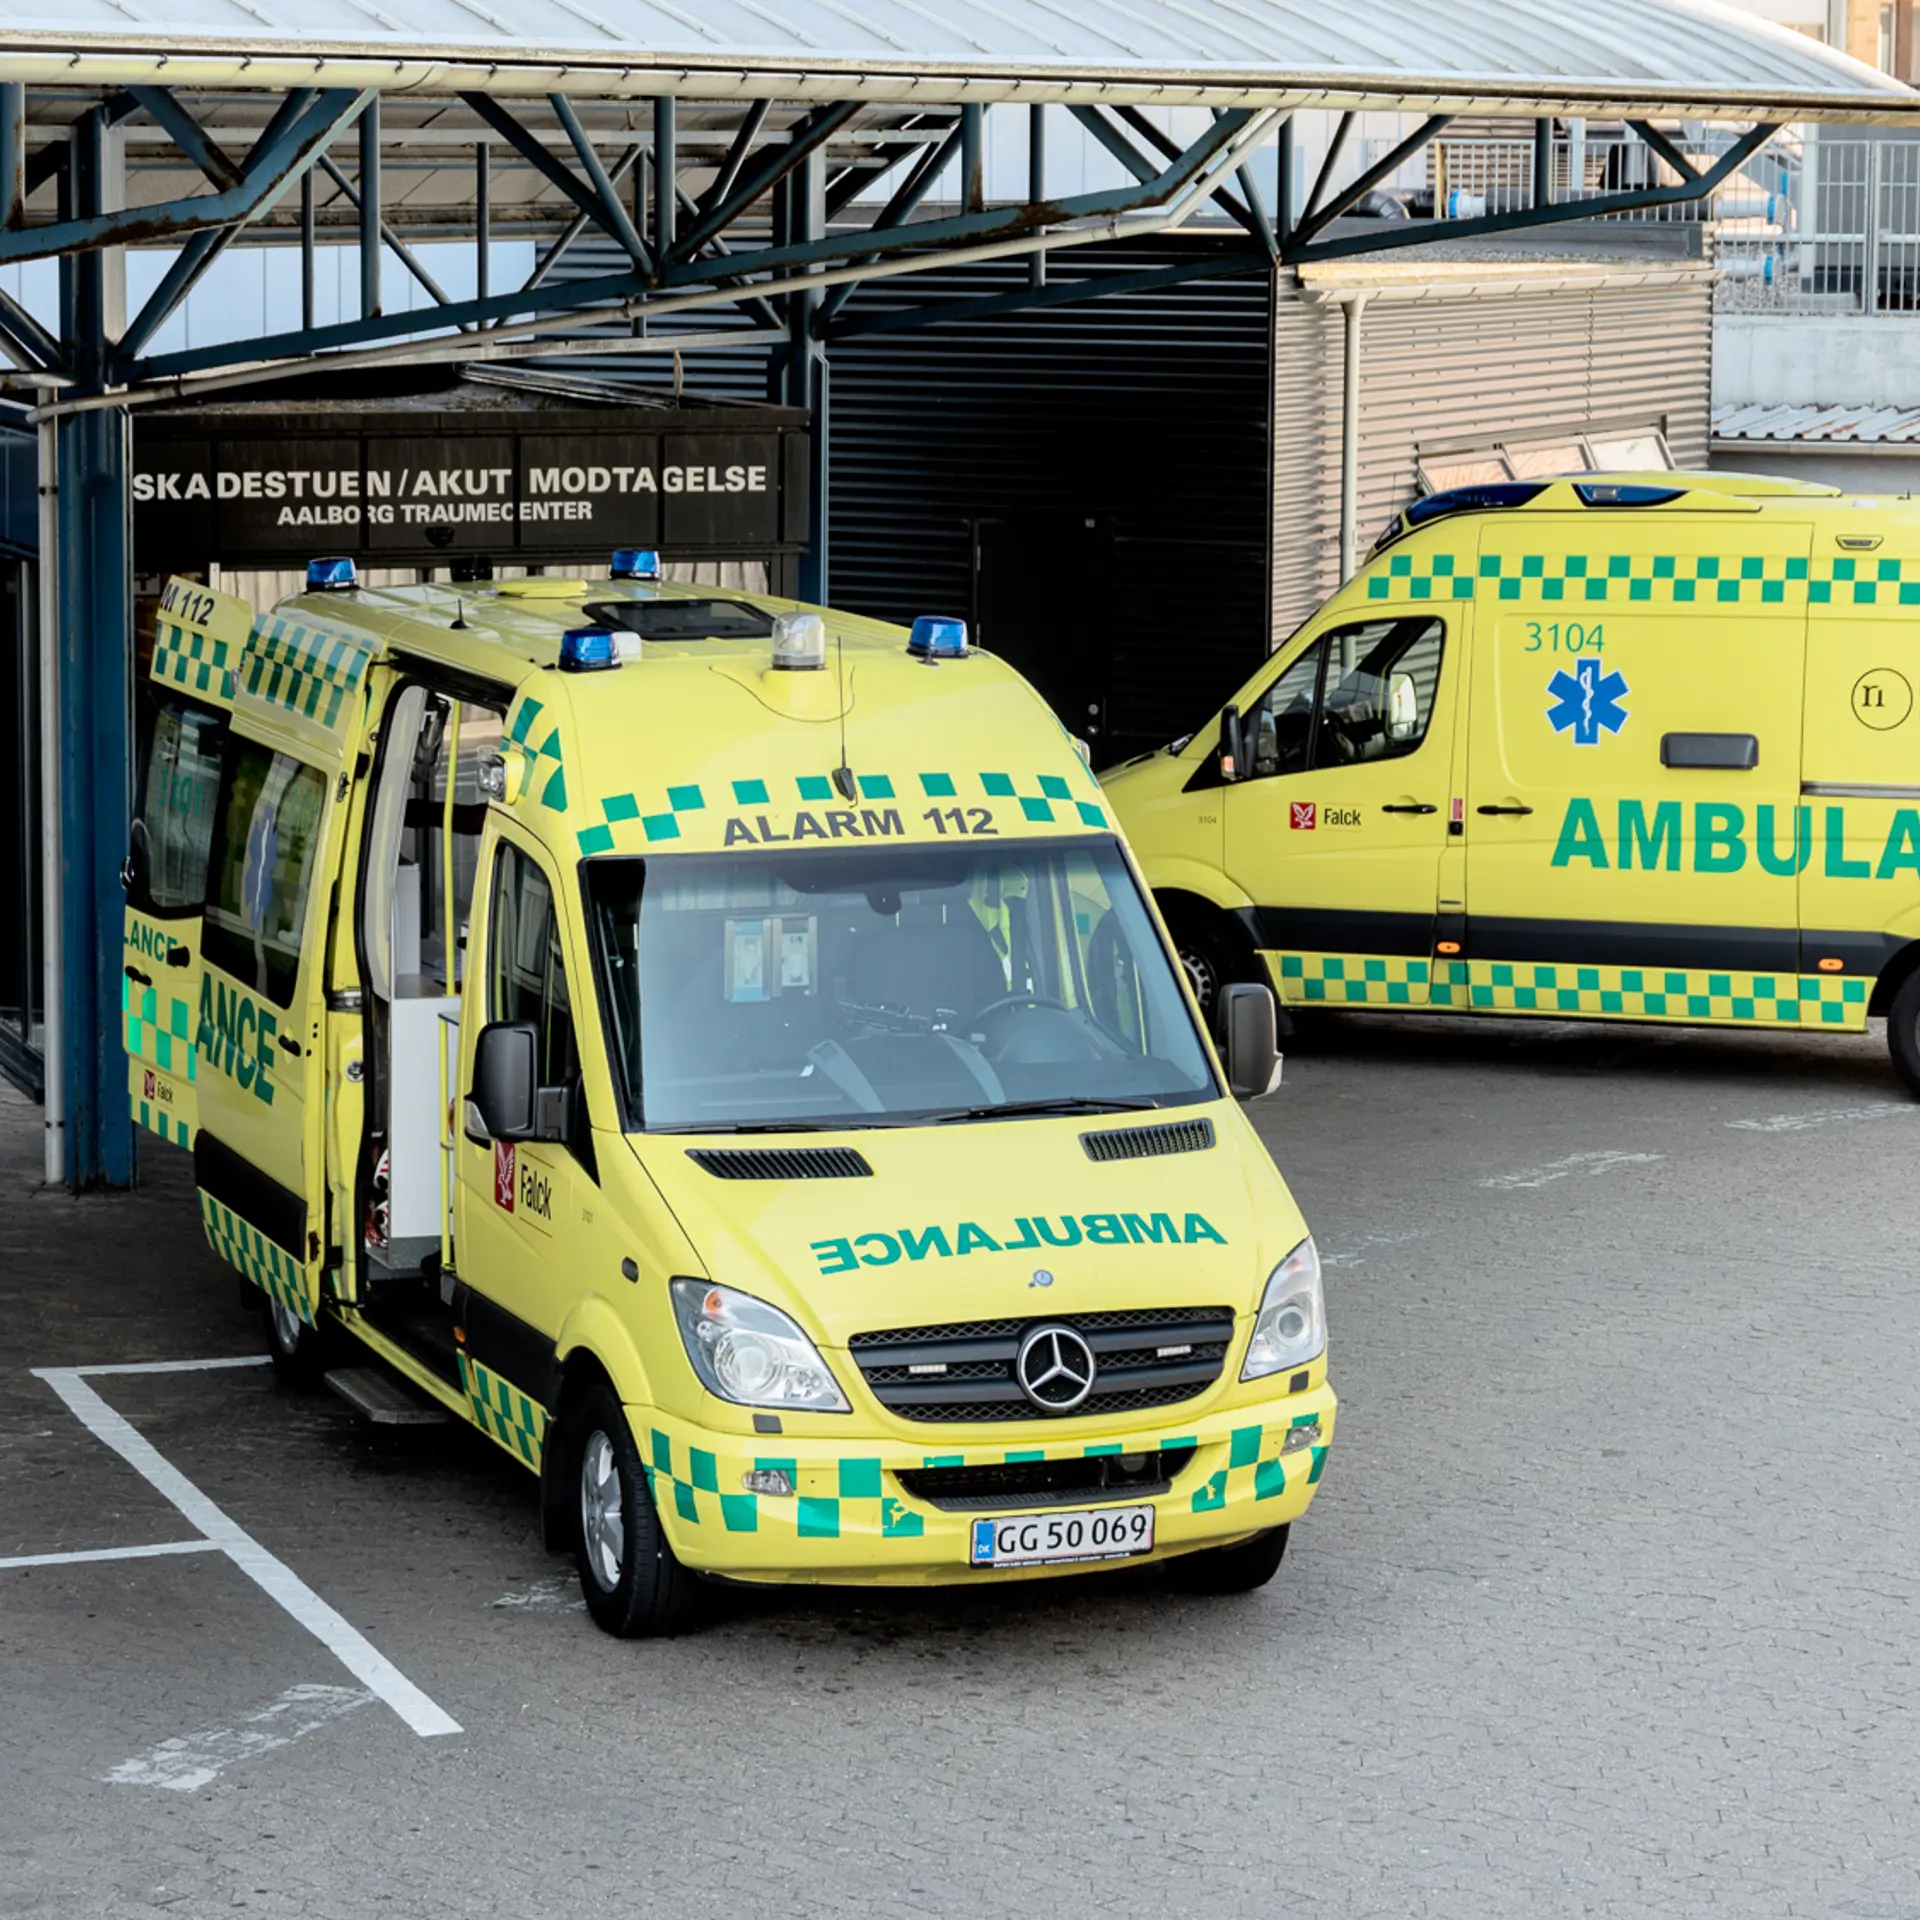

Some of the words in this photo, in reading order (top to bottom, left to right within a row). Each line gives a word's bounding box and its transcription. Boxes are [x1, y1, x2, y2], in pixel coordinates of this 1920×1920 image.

[529, 465, 767, 494] MODTAGELSE
[277, 504, 394, 526] AALBORG
[400, 501, 593, 523] TRAUMECENTER
[180, 590, 215, 626] 112
[1524, 622, 1605, 653] 3104
[723, 808, 905, 847] ALARM
[922, 807, 999, 835] 112
[1323, 808, 1362, 827] Falck
[1550, 797, 1920, 880] AMBULA
[520, 1162, 552, 1221] Falck
[997, 1523, 1038, 1554] GG
[1091, 1514, 1147, 1546] 069
